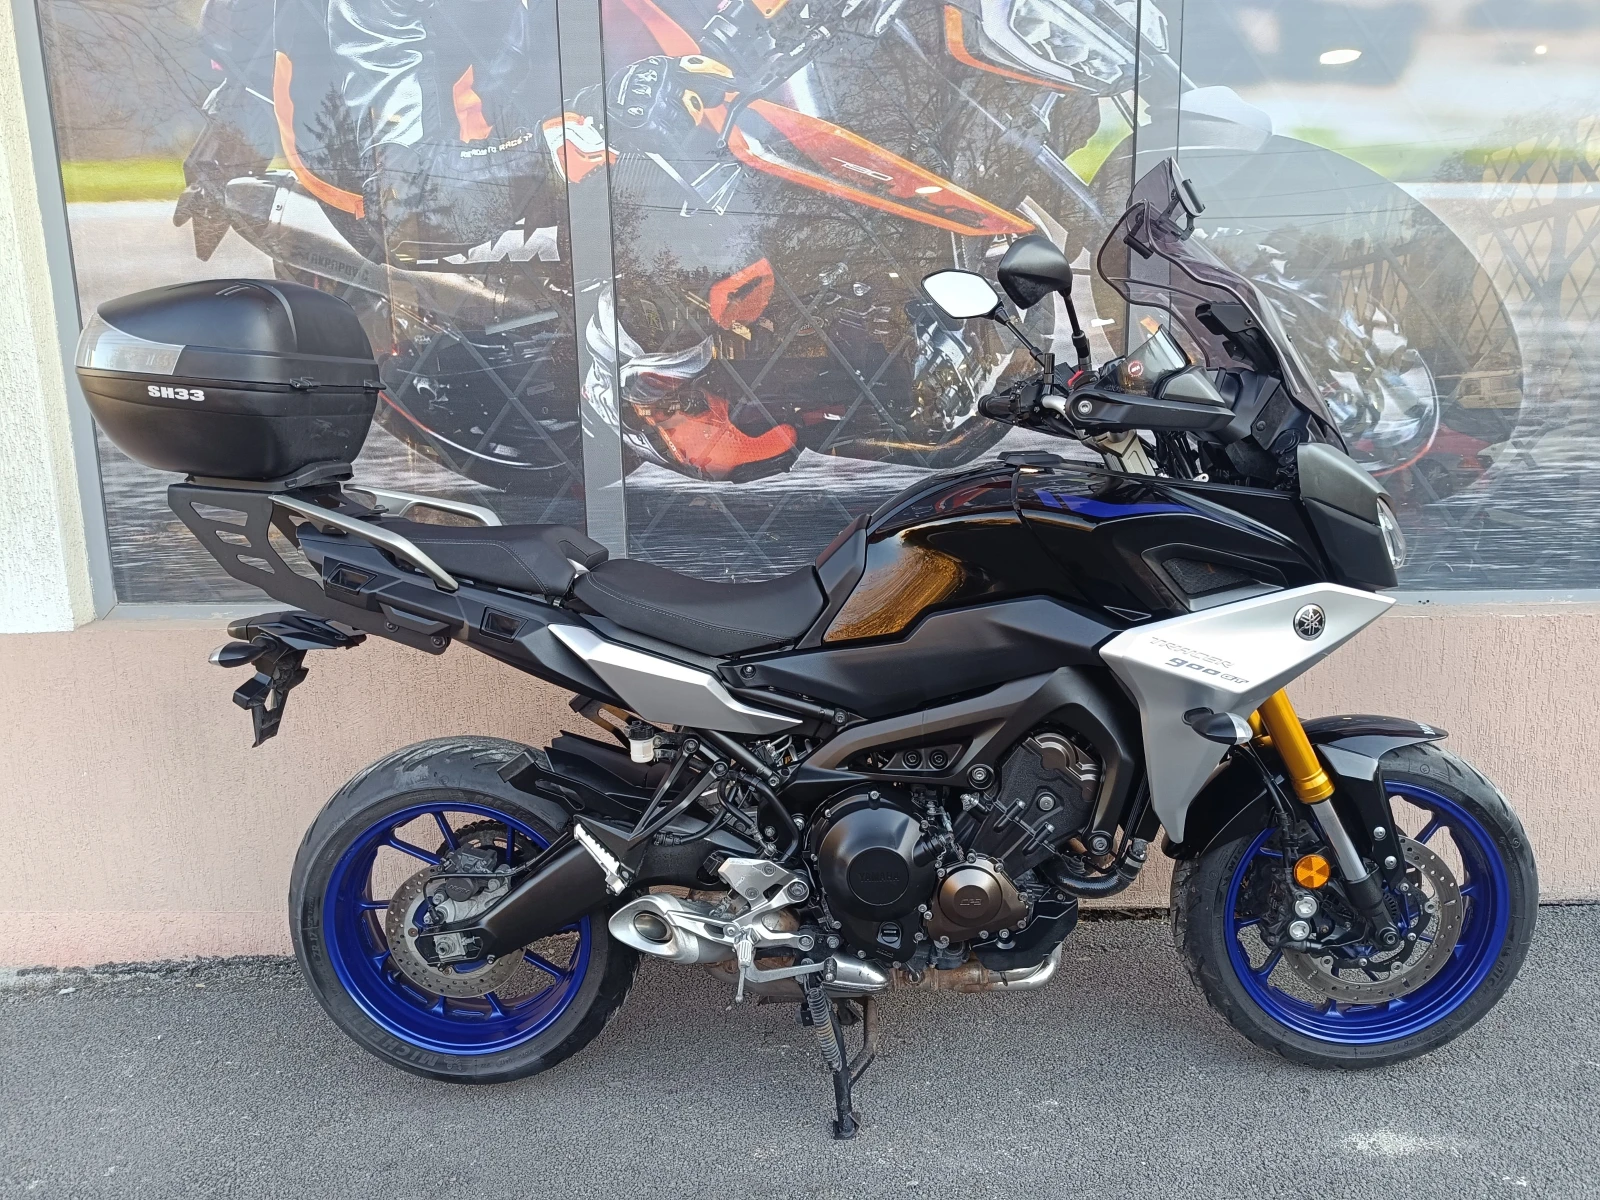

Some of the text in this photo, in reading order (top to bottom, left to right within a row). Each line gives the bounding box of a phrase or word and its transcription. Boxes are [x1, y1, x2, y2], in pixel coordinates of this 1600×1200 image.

[147, 385, 205, 402] SH33
[1150, 636, 1235, 669] TRACER
[1164, 657, 1221, 677] 900
